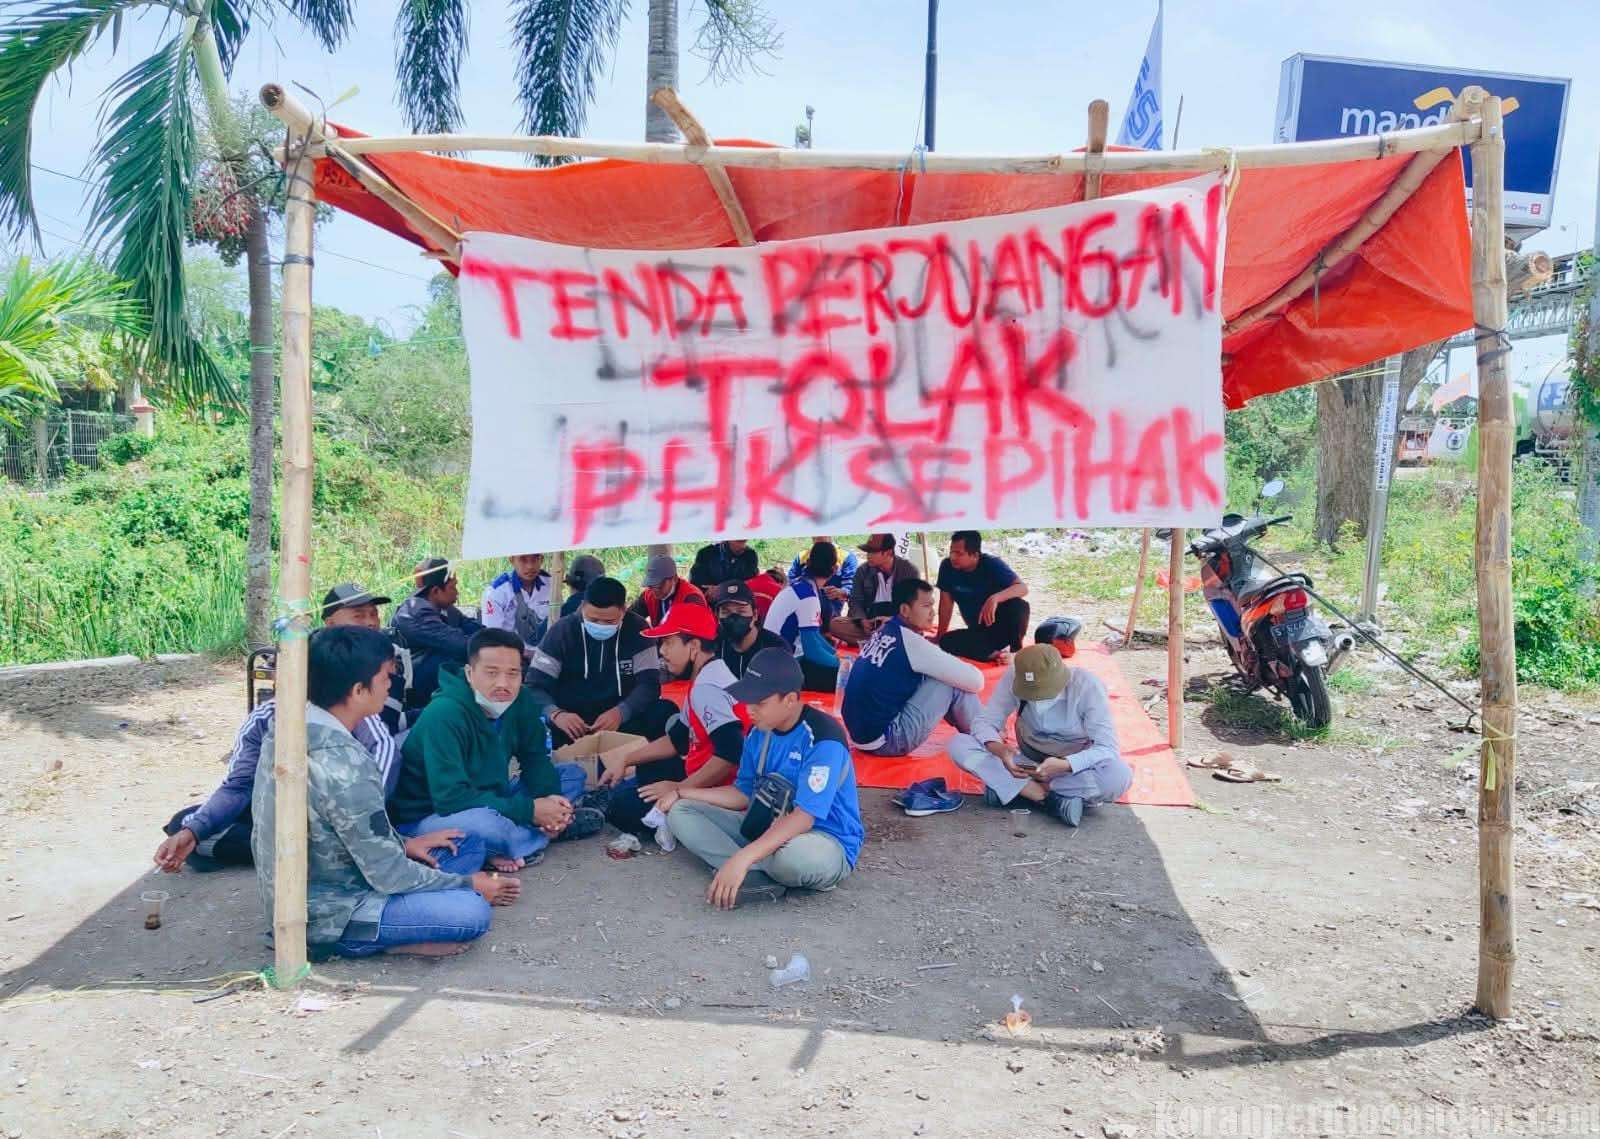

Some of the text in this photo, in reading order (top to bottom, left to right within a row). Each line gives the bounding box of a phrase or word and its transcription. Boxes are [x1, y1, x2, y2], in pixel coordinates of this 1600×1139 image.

[461, 184, 1222, 340] TENDA PERJUANGAN
[650, 326, 1096, 443] TOLAK
[847, 405, 1222, 530] SEPIHAK
